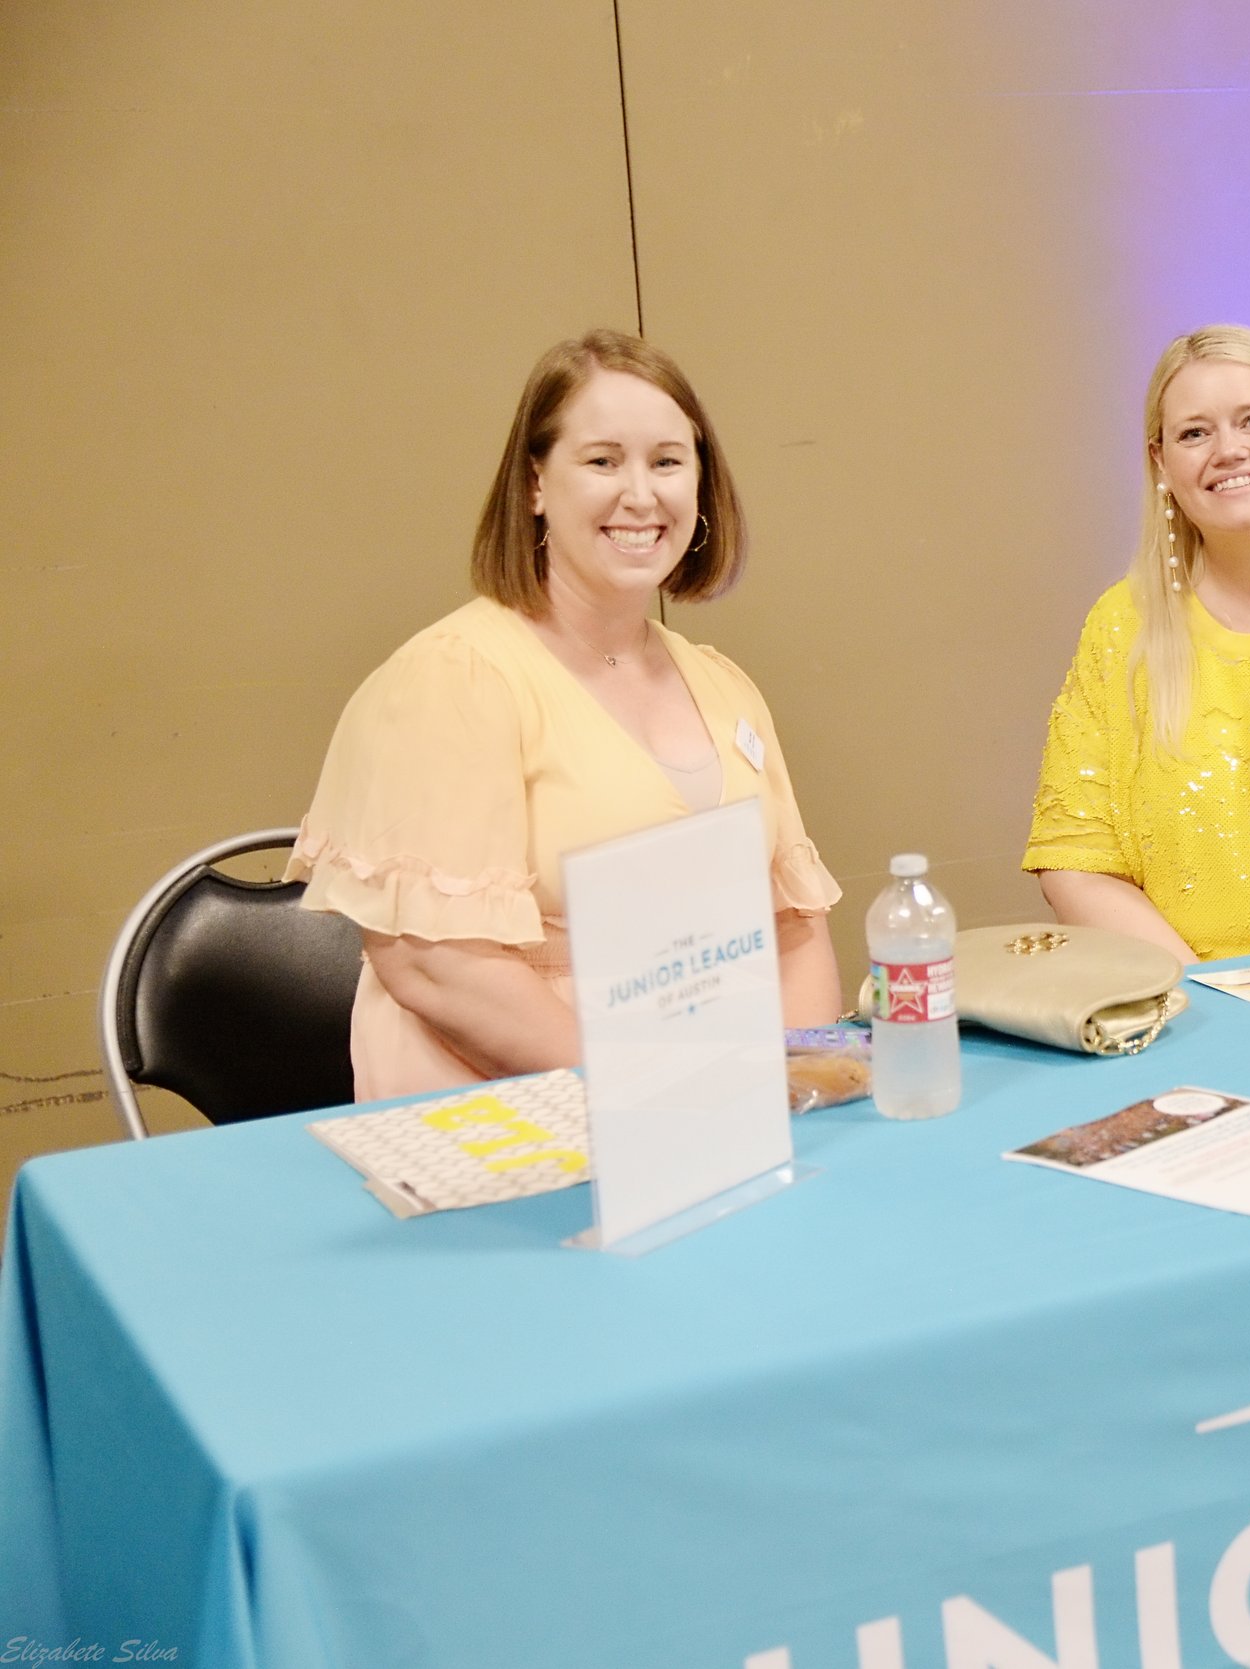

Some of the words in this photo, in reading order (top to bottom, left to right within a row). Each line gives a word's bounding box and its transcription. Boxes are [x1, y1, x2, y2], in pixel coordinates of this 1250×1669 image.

[673, 935, 695, 950] THE
[607, 960, 684, 1008] JUNIOR
[690, 929, 764, 974] LEAGUE
[678, 976, 721, 1001] AUSTIN
